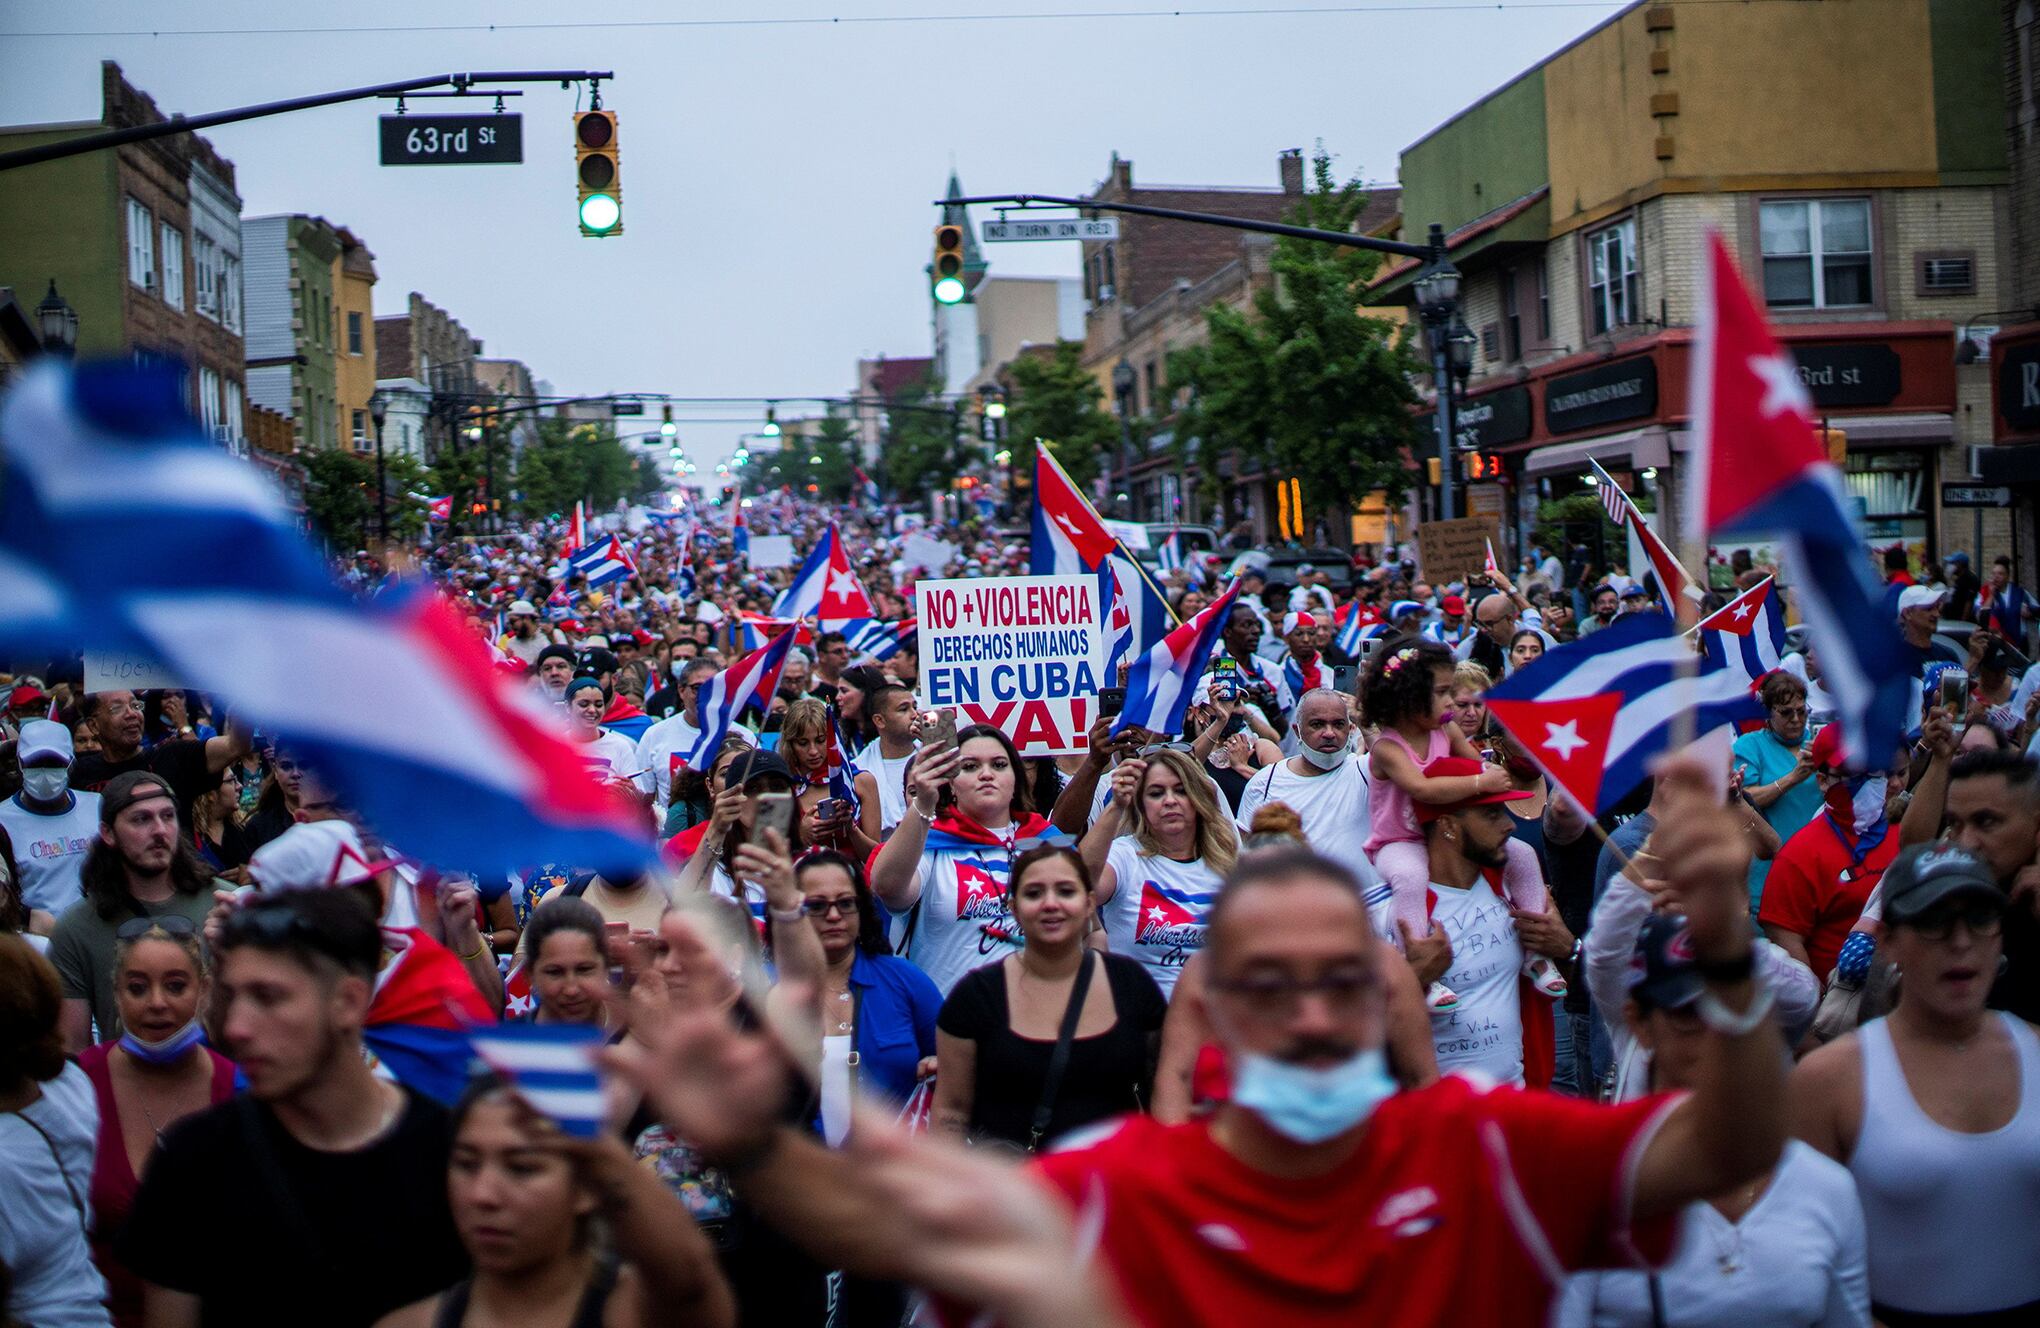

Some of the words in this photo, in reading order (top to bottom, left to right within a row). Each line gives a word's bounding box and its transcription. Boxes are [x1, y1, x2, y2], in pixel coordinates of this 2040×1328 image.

[406, 127, 468, 153] 63rd
[478, 126, 497, 144] St
[989, 226, 1008, 238] NO
[1016, 225, 1050, 237] TURN
[1057, 224, 1078, 236] ON
[1084, 222, 1112, 235] RED
[926, 589, 957, 630] NO
[934, 632, 1013, 663] DERECHOS
[1016, 629, 1089, 657] HUMANOS
[100, 652, 153, 678] Liber
[929, 666, 980, 705] EN
[991, 660, 1099, 701] CUBA
[942, 698, 1089, 751] YA!
